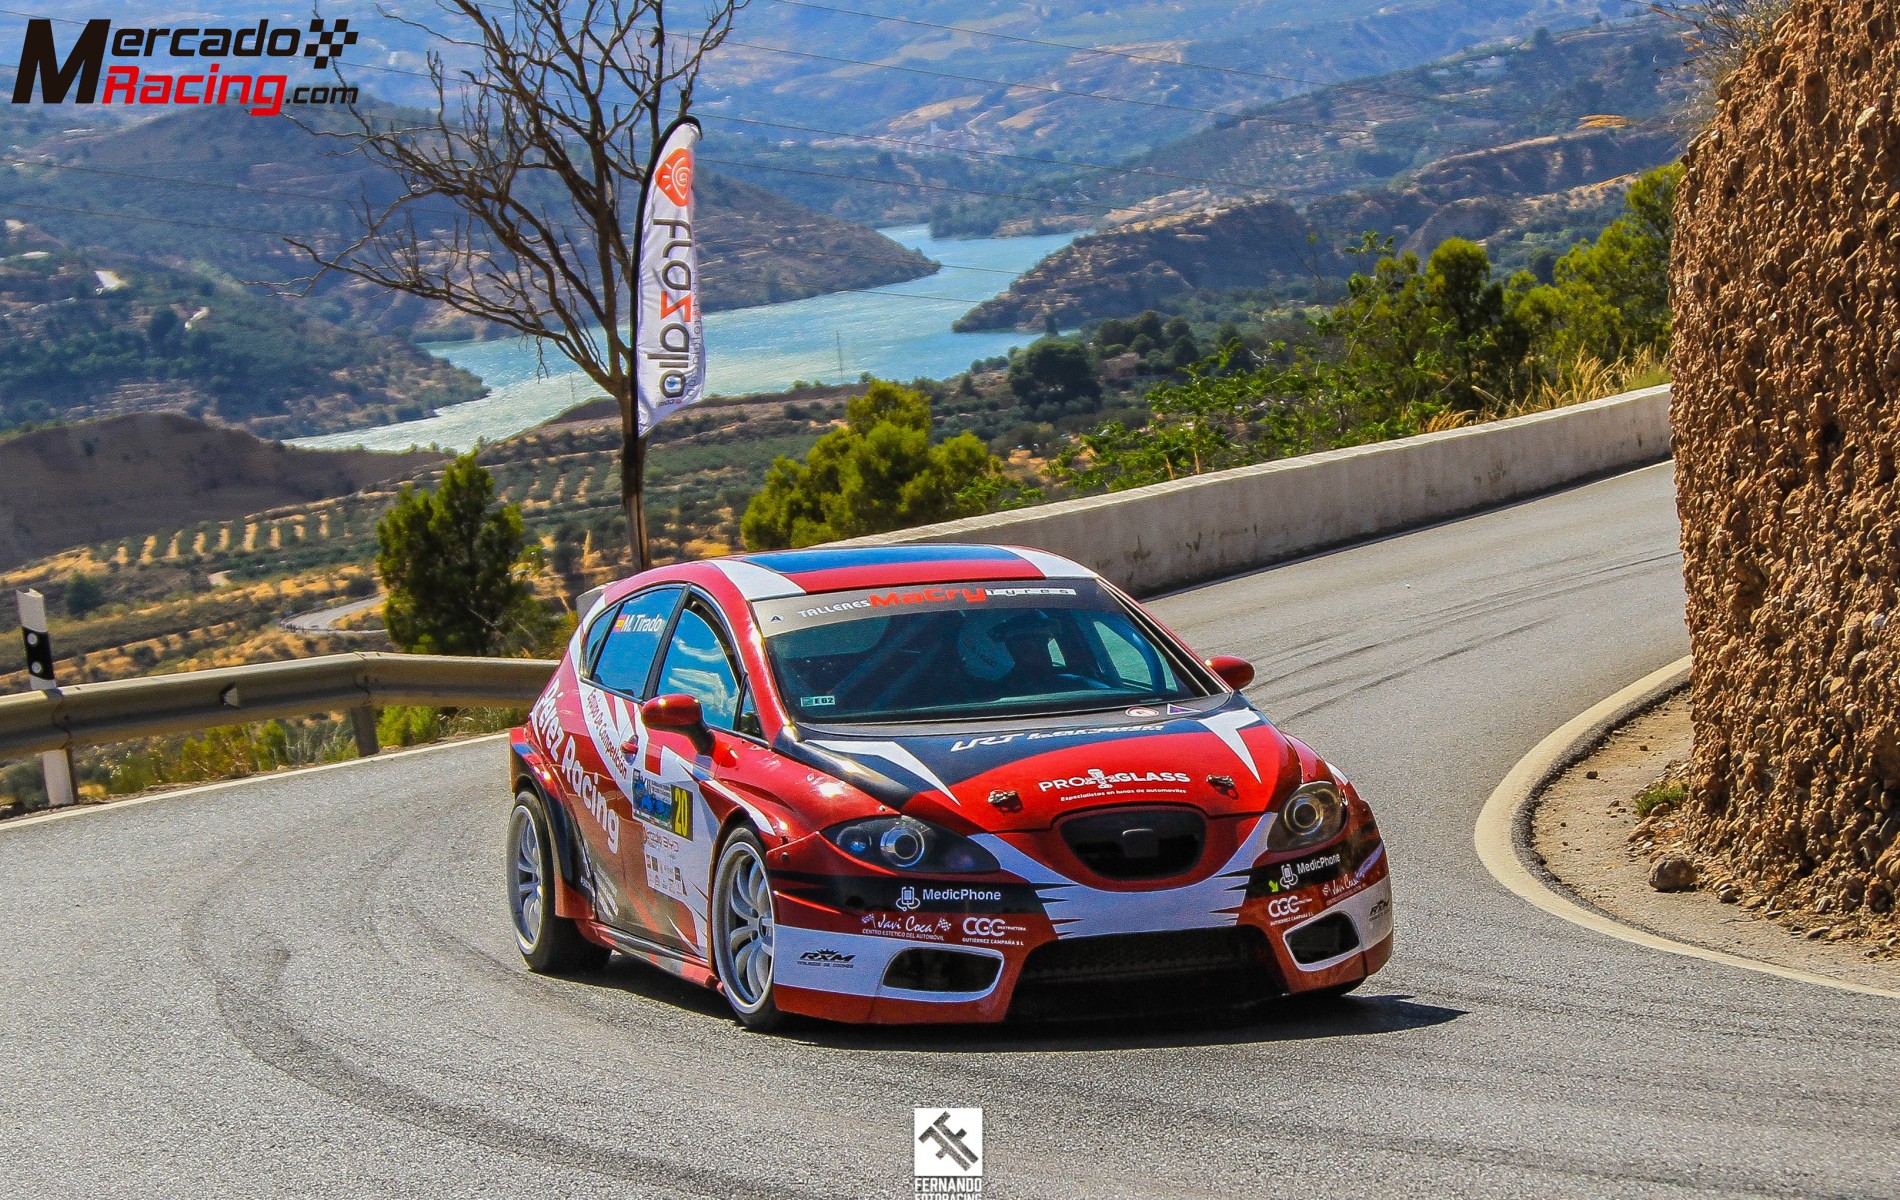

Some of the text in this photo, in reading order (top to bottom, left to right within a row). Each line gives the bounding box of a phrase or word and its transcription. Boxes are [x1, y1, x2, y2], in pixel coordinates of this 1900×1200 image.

[797, 599, 871, 618] TALLERES
[868, 587, 987, 608] MaCry
[632, 613, 663, 632] Tirado
[561, 735, 620, 854] Racing
[1060, 791, 1105, 802] Especialistas
[674, 786, 688, 837] 20
[1296, 852, 1341, 875] MedicPhone
[922, 888, 1001, 901] MedicPhone
[1268, 895, 1300, 917] CGC
[862, 928, 881, 936] CENTRO
[878, 913, 933, 933] Javi Coca
